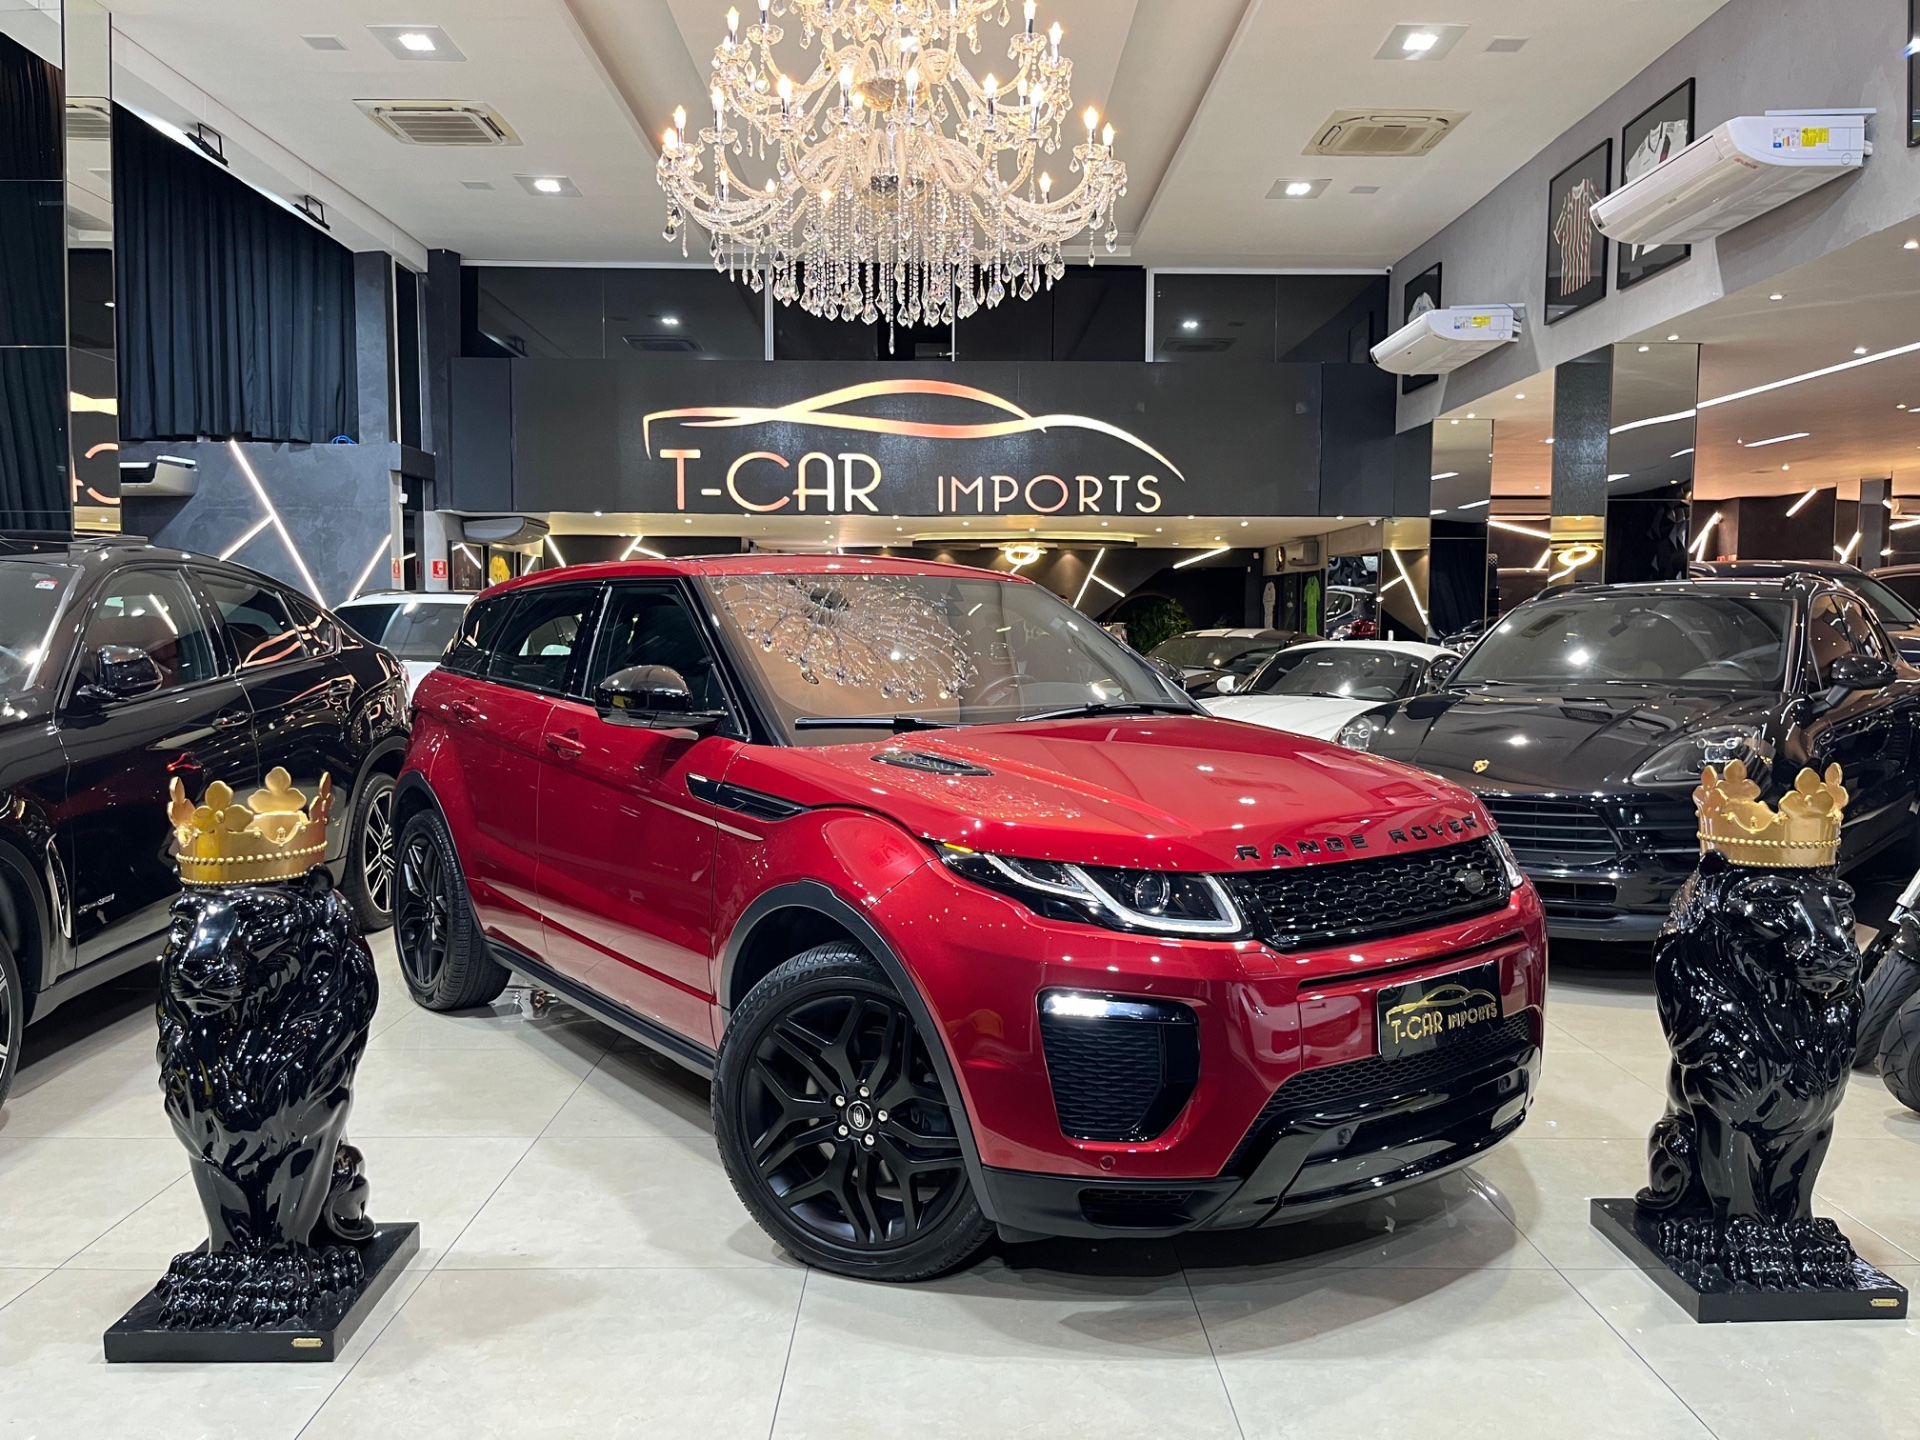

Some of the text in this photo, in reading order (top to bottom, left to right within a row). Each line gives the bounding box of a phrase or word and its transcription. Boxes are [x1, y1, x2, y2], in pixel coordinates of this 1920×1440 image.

[659, 448, 1162, 513] T-CAR IMPORTS
[1235, 816, 1478, 861] RANGE ROVER
[1391, 1002, 1498, 1044] T-CAR IMPORTS
